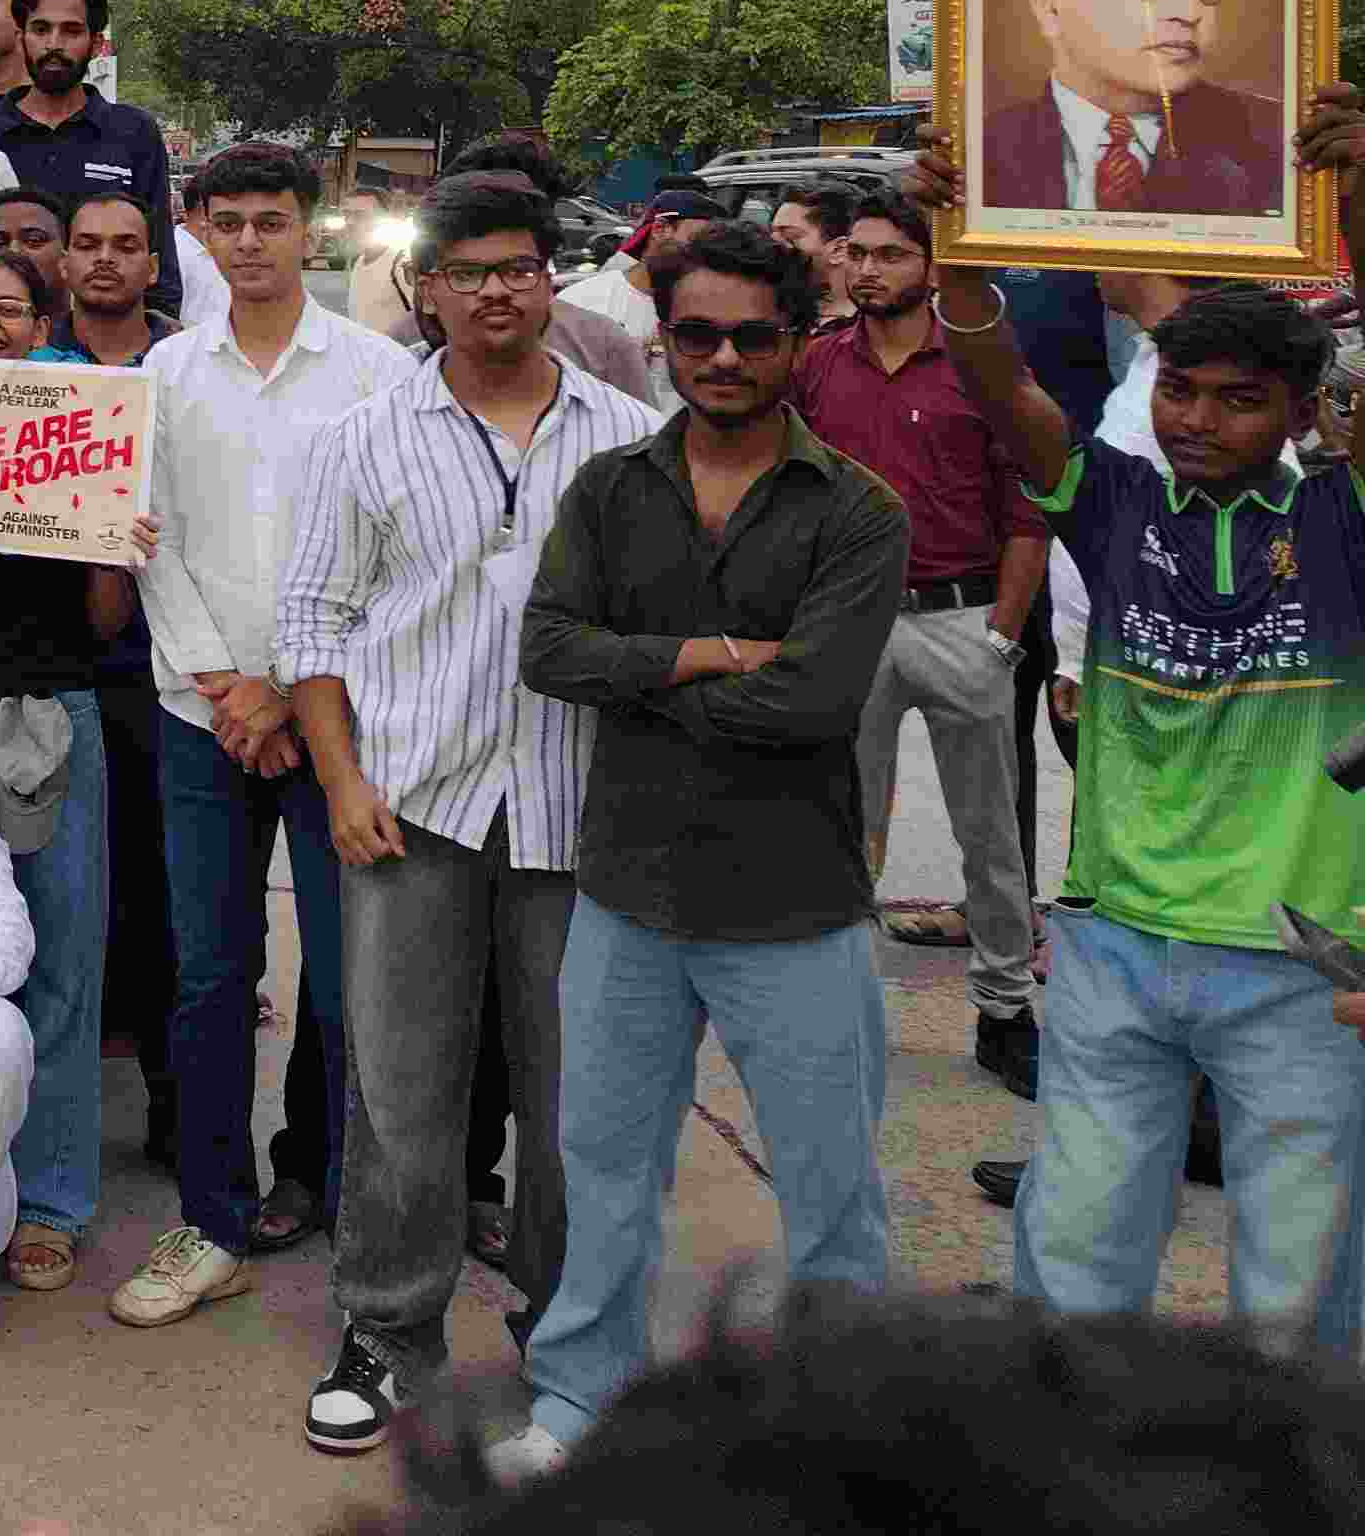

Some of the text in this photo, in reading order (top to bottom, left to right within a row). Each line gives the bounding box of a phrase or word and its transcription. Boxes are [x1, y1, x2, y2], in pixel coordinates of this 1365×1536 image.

[13, 383, 70, 399] AGAINST
[27, 395, 61, 409] LEAK
[14, 408, 93, 456] ARE
[2, 510, 60, 526] AGAINST
[17, 524, 80, 541] MINISTER
[1124, 646, 1310, 681] SMARTPONES
